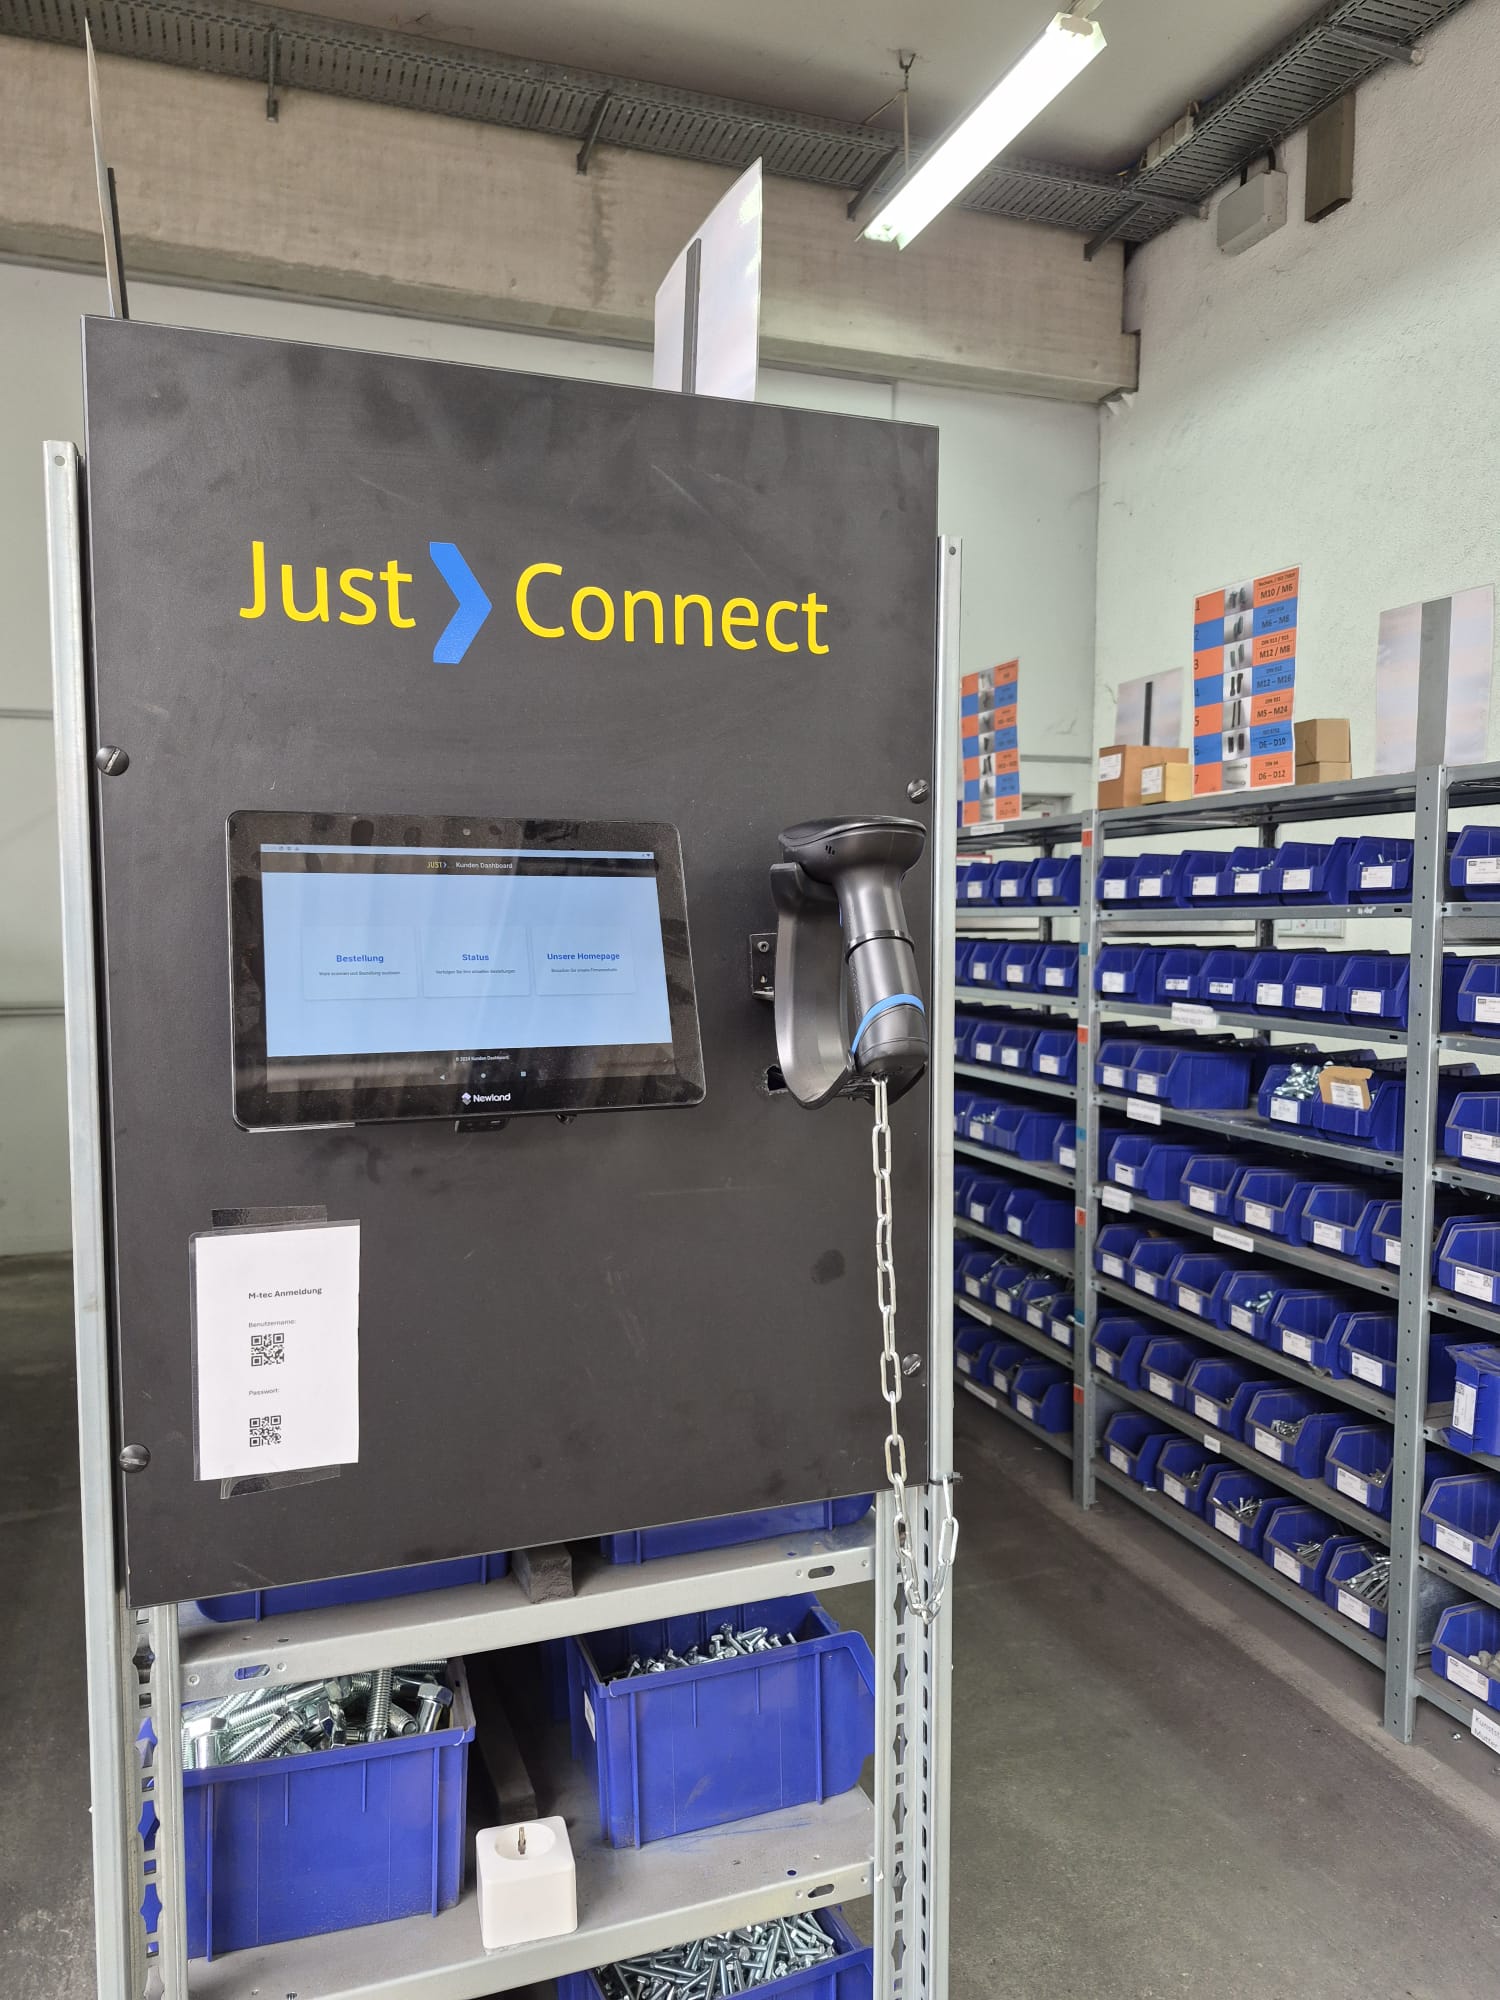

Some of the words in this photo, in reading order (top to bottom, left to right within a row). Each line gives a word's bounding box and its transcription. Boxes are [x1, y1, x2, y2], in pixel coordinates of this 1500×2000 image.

[1260, 588, 1275, 600] M10
[1281, 583, 1293, 593] M6
[239, 540, 416, 629] Just
[515, 562, 830, 655] Connect
[1259, 648, 1274, 659] M12
[1257, 710, 1267, 719] M5
[1274, 737, 1286, 747] D10
[1273, 769, 1286, 779] D12
[455, 861, 479, 869] Kunden
[480, 861, 513, 869] Dashboard
[336, 954, 384, 964] Bestellung
[462, 953, 489, 961] Status
[547, 952, 575, 960] Unsere
[577, 952, 621, 961] Homepage
[472, 1092, 511, 1103] Newland
[274, 1288, 322, 1297] Anmeldung
[249, 1319, 296, 1328] Benutzername:
[249, 1388, 280, 1396] Passwort:
